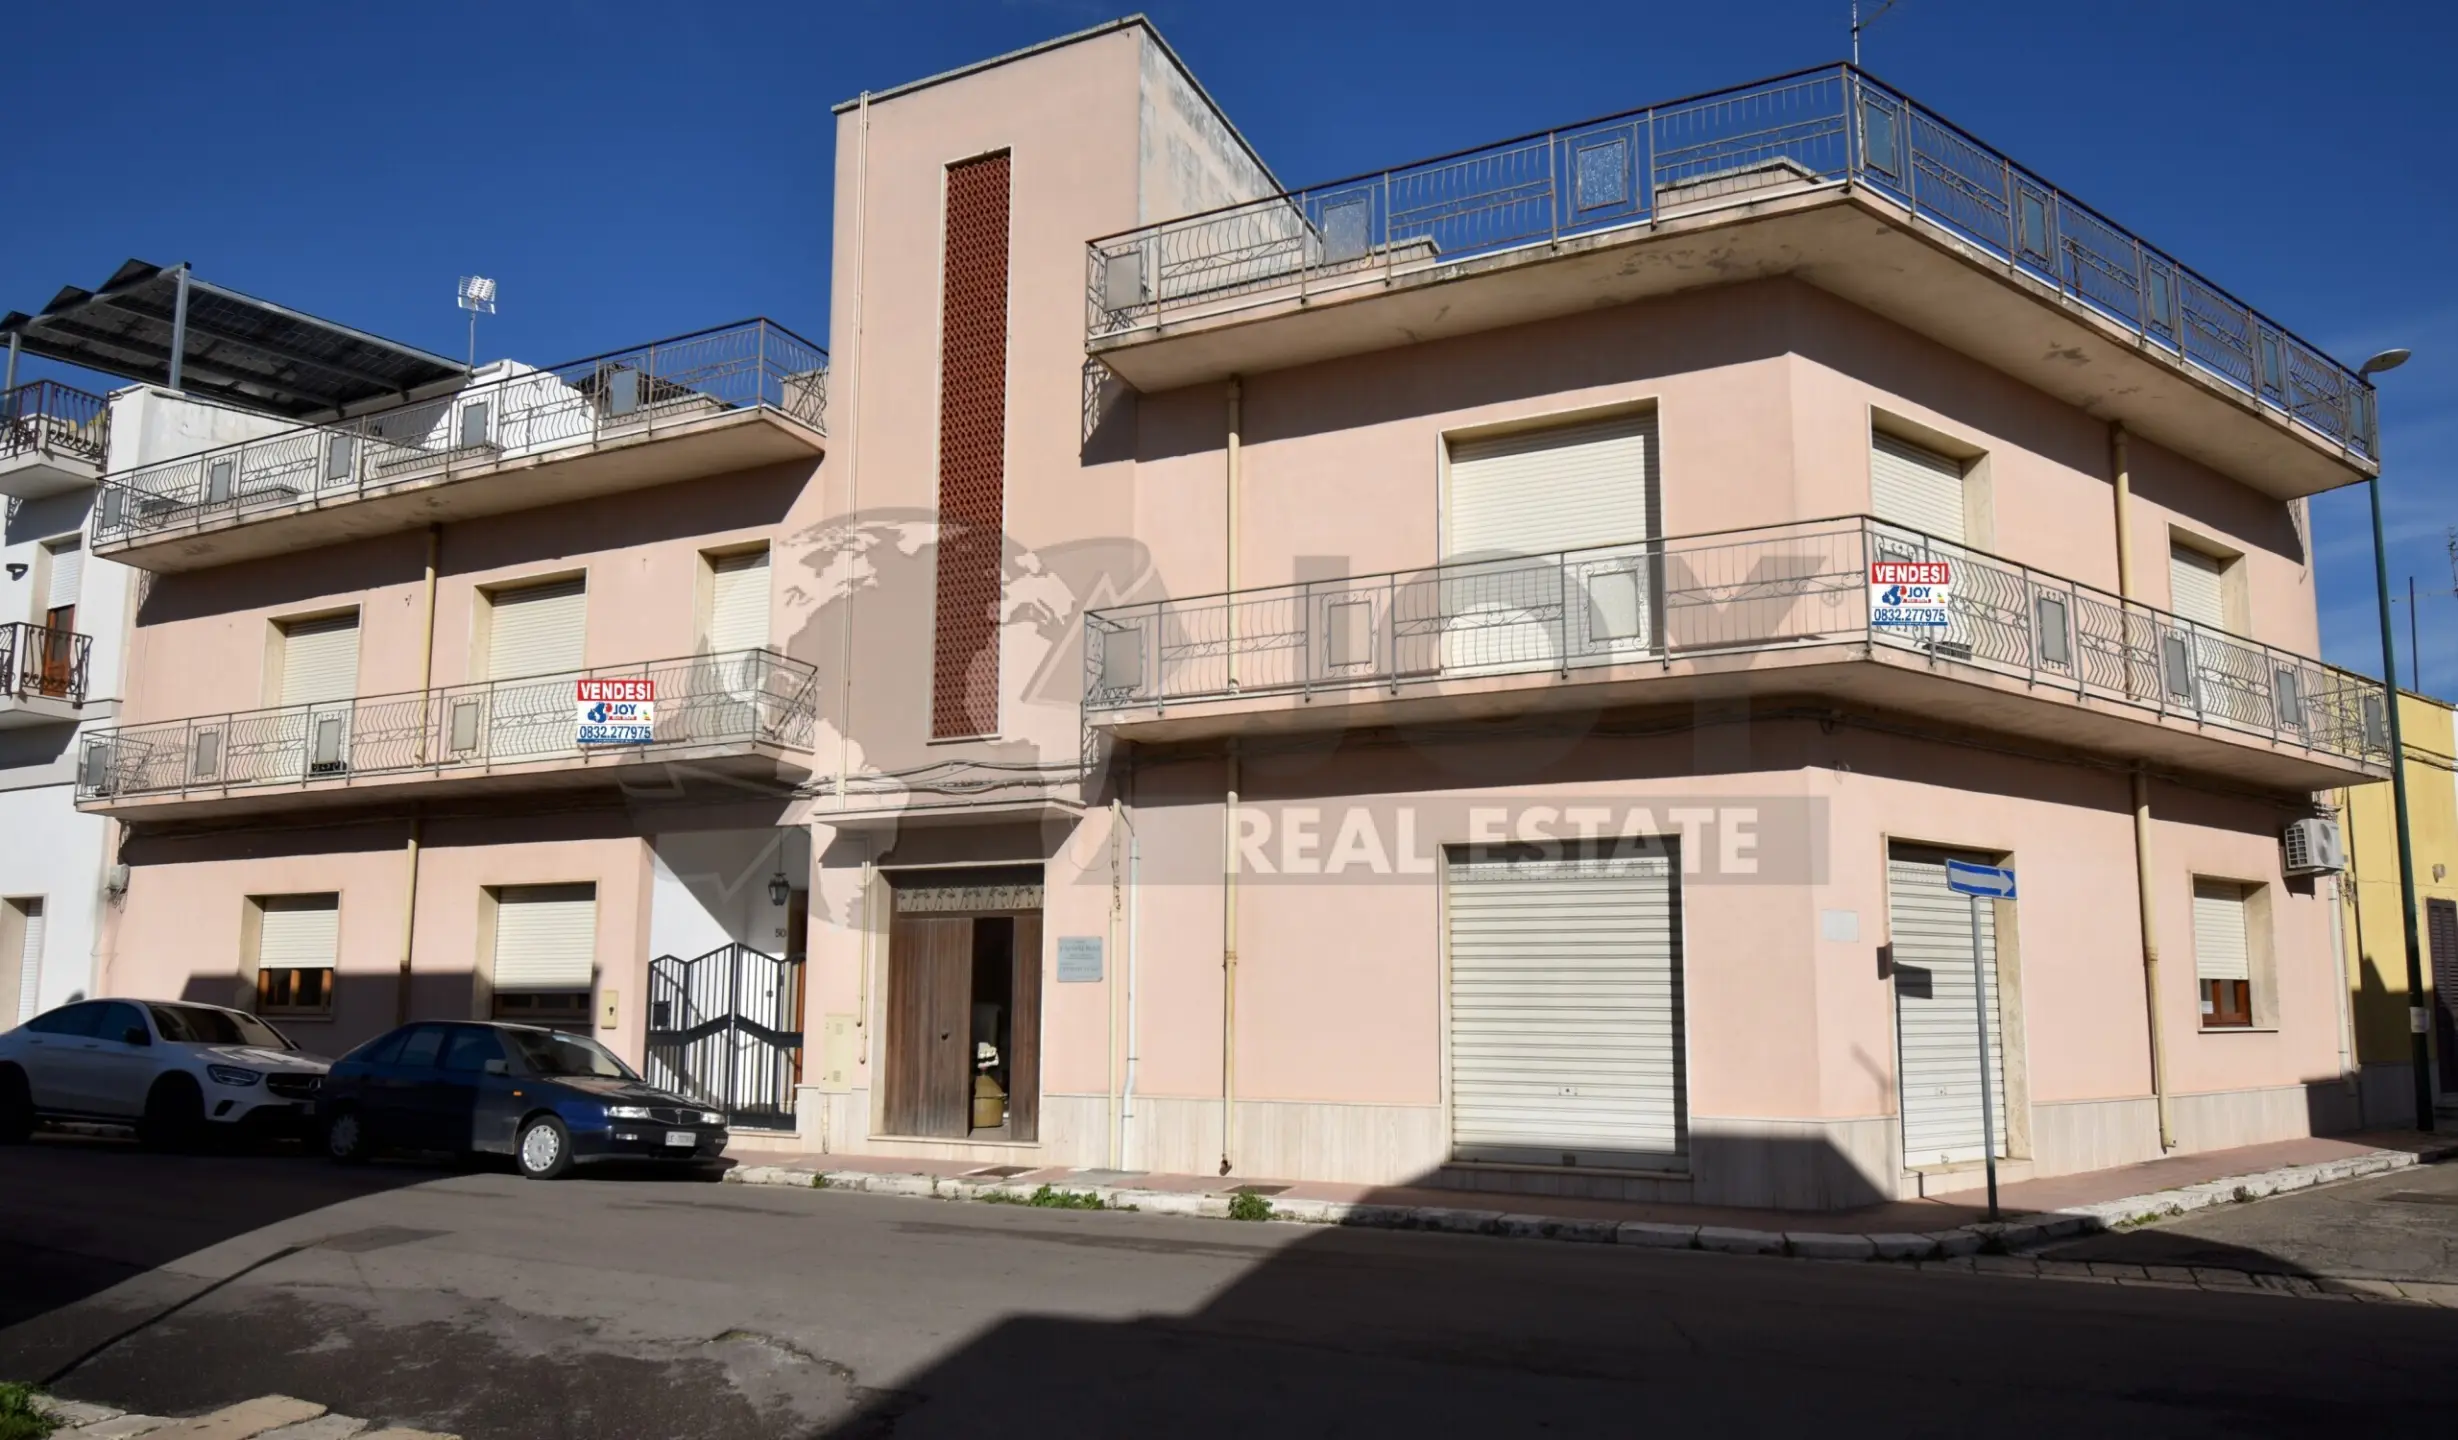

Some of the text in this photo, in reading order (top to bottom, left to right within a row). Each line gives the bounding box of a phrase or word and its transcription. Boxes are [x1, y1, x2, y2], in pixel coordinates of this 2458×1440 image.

[1875, 565, 1946, 583] VENDESI
[1907, 586, 1931, 598] JOY
[1874, 608, 1946, 622] 0832.277975
[580, 682, 651, 700] VENDESI
[613, 704, 637, 715] JOY
[579, 726, 651, 739] 0832.277975
[775, 928, 787, 938] 50
